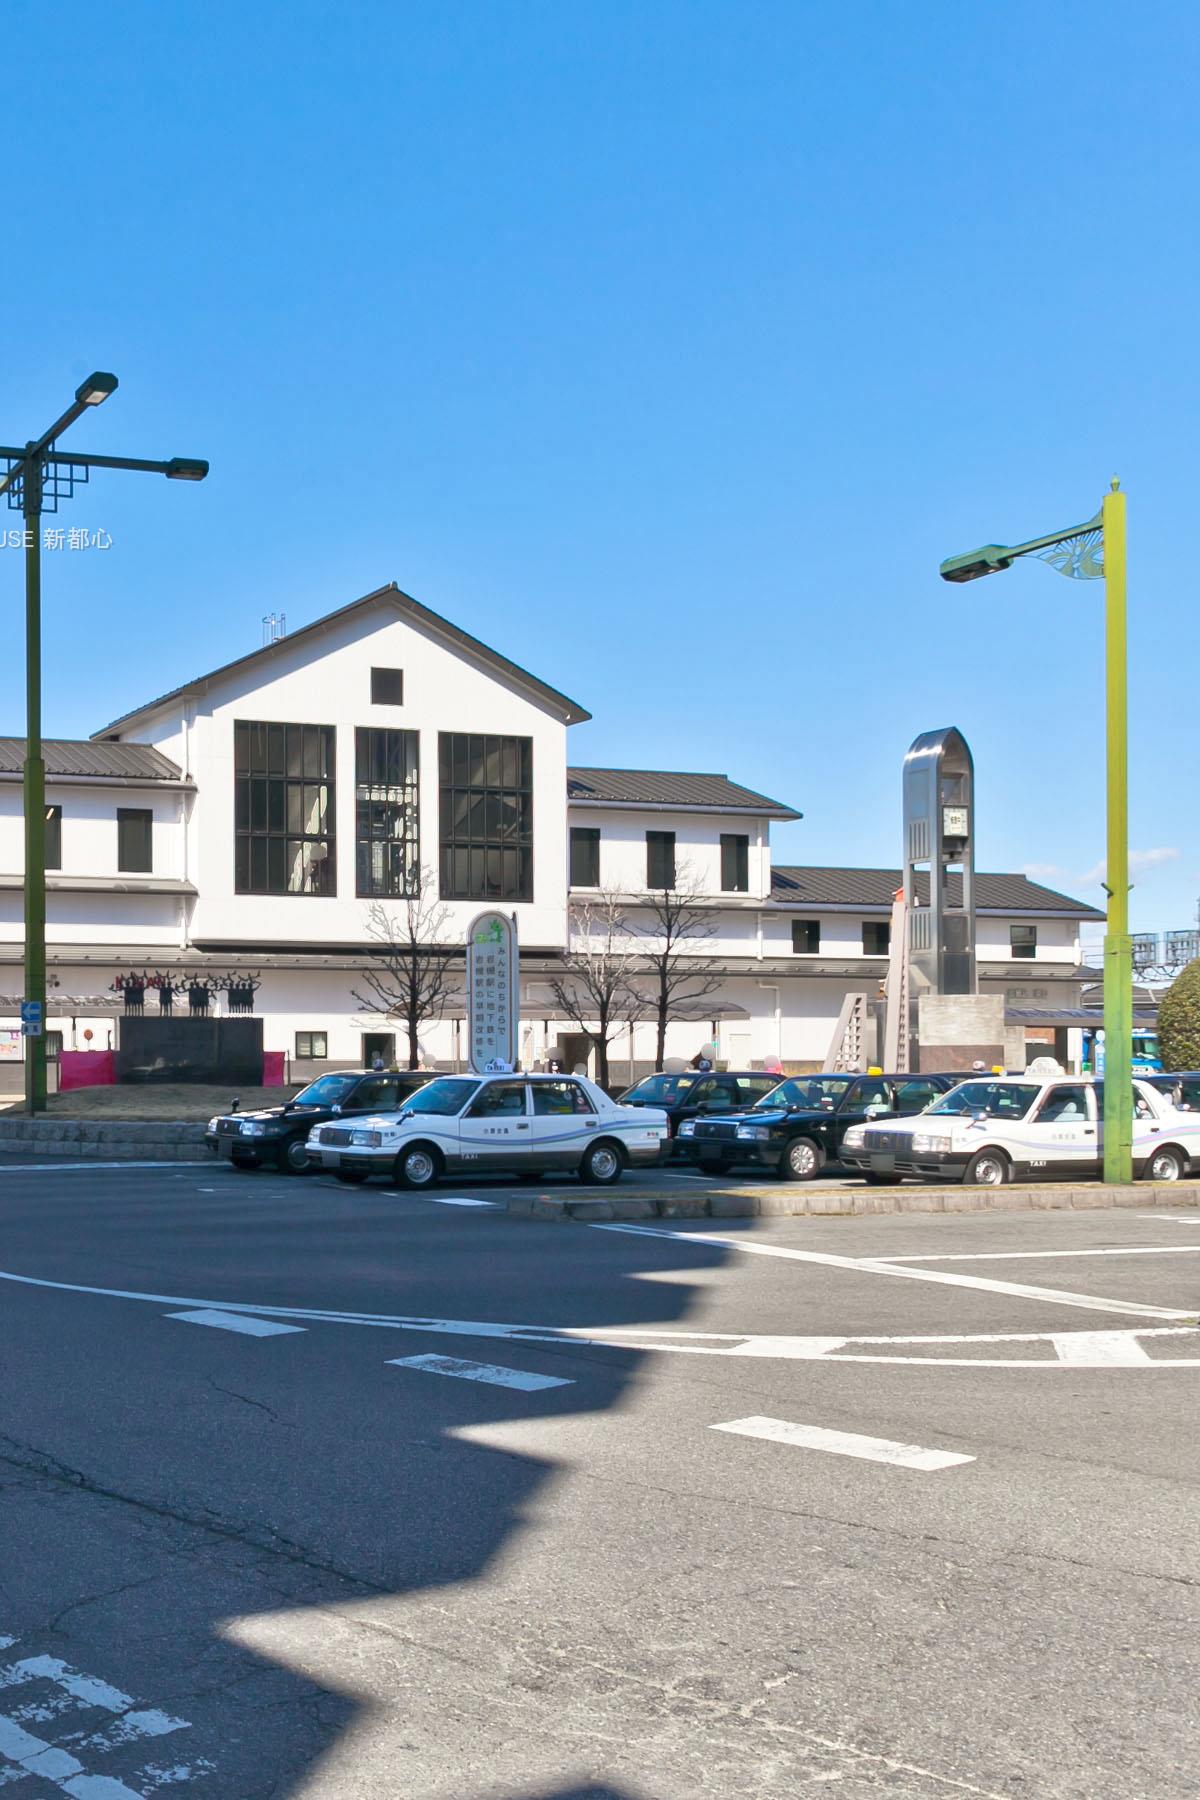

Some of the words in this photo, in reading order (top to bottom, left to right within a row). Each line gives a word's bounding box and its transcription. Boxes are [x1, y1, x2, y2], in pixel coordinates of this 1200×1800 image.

[497, 946, 506, 1036] みんなのちからで
